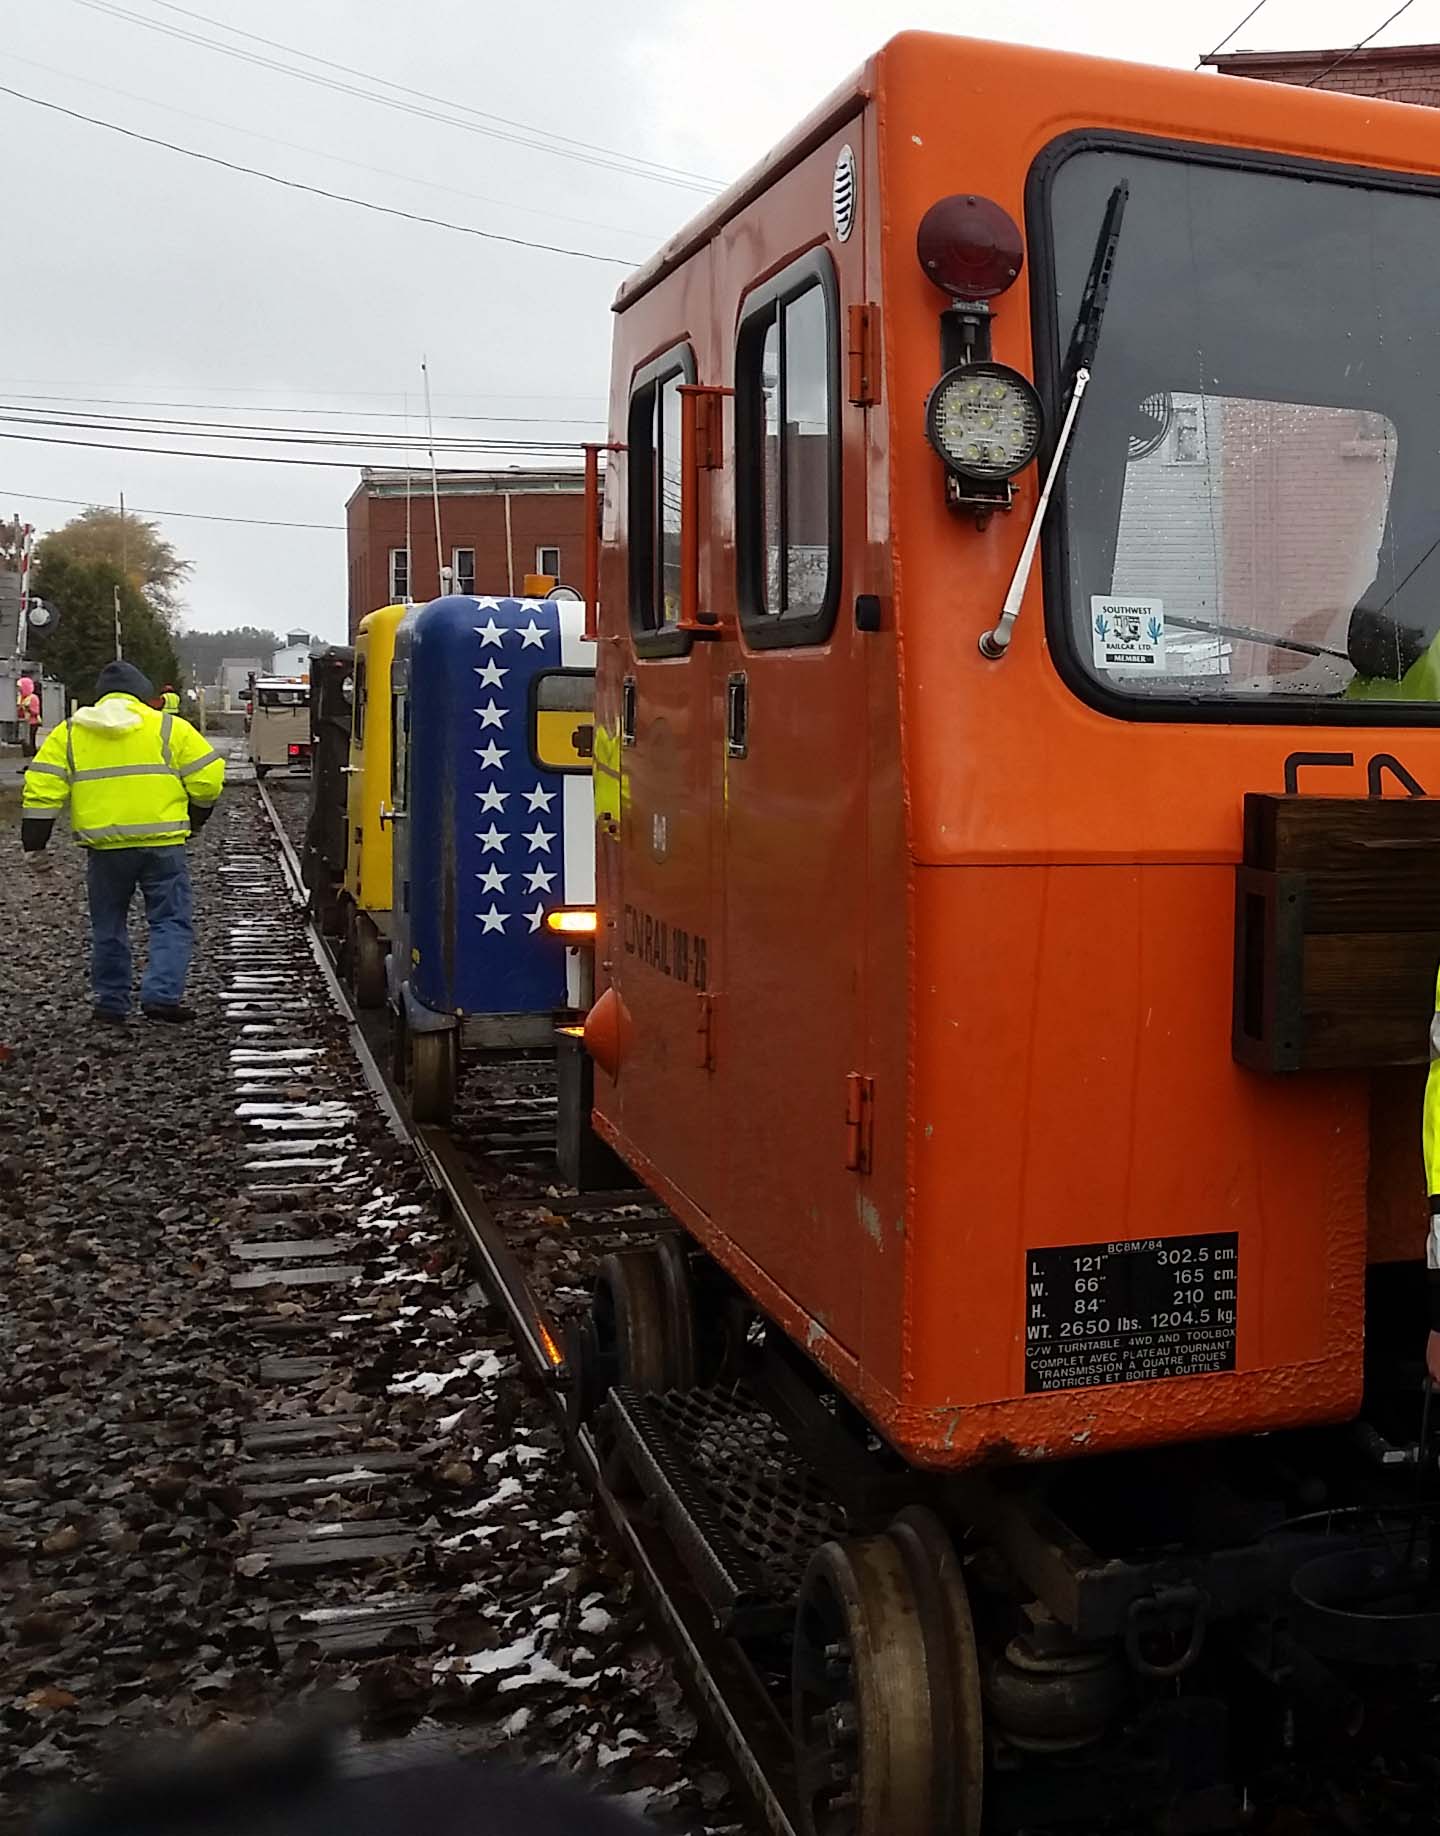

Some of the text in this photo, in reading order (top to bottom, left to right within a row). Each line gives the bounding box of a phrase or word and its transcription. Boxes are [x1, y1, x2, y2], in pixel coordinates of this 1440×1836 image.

[1102, 606, 1152, 615] SOUTHWEST
[1113, 655, 1146, 663] MEMBER
[1032, 1262, 1045, 1276] L.
[1157, 1248, 1209, 1265] 302.5
[1214, 1248, 1238, 1260] cm.
[1030, 1282, 1049, 1297] W.
[1173, 1269, 1204, 1284] 165
[1214, 1269, 1238, 1281] cm.
[1032, 1304, 1046, 1318] H.
[1173, 1289, 1204, 1305] 210
[1214, 1289, 1237, 1301] cm.
[1027, 1308, 1237, 1340] WT. 2650 lbs. 1204.5 kg.
[1026, 1328, 1235, 1357] C/W TURNTABLE 4WD AND TOOLBOX
[1030, 1341, 1231, 1370] COMPLET AVEC PLATEAU TOURNANT
[1038, 1351, 1226, 1379] TRANSMISSION A QUATRE ROUES
[1042, 1362, 1220, 1389] MOTRICES ET BOITE A OUTTILS
